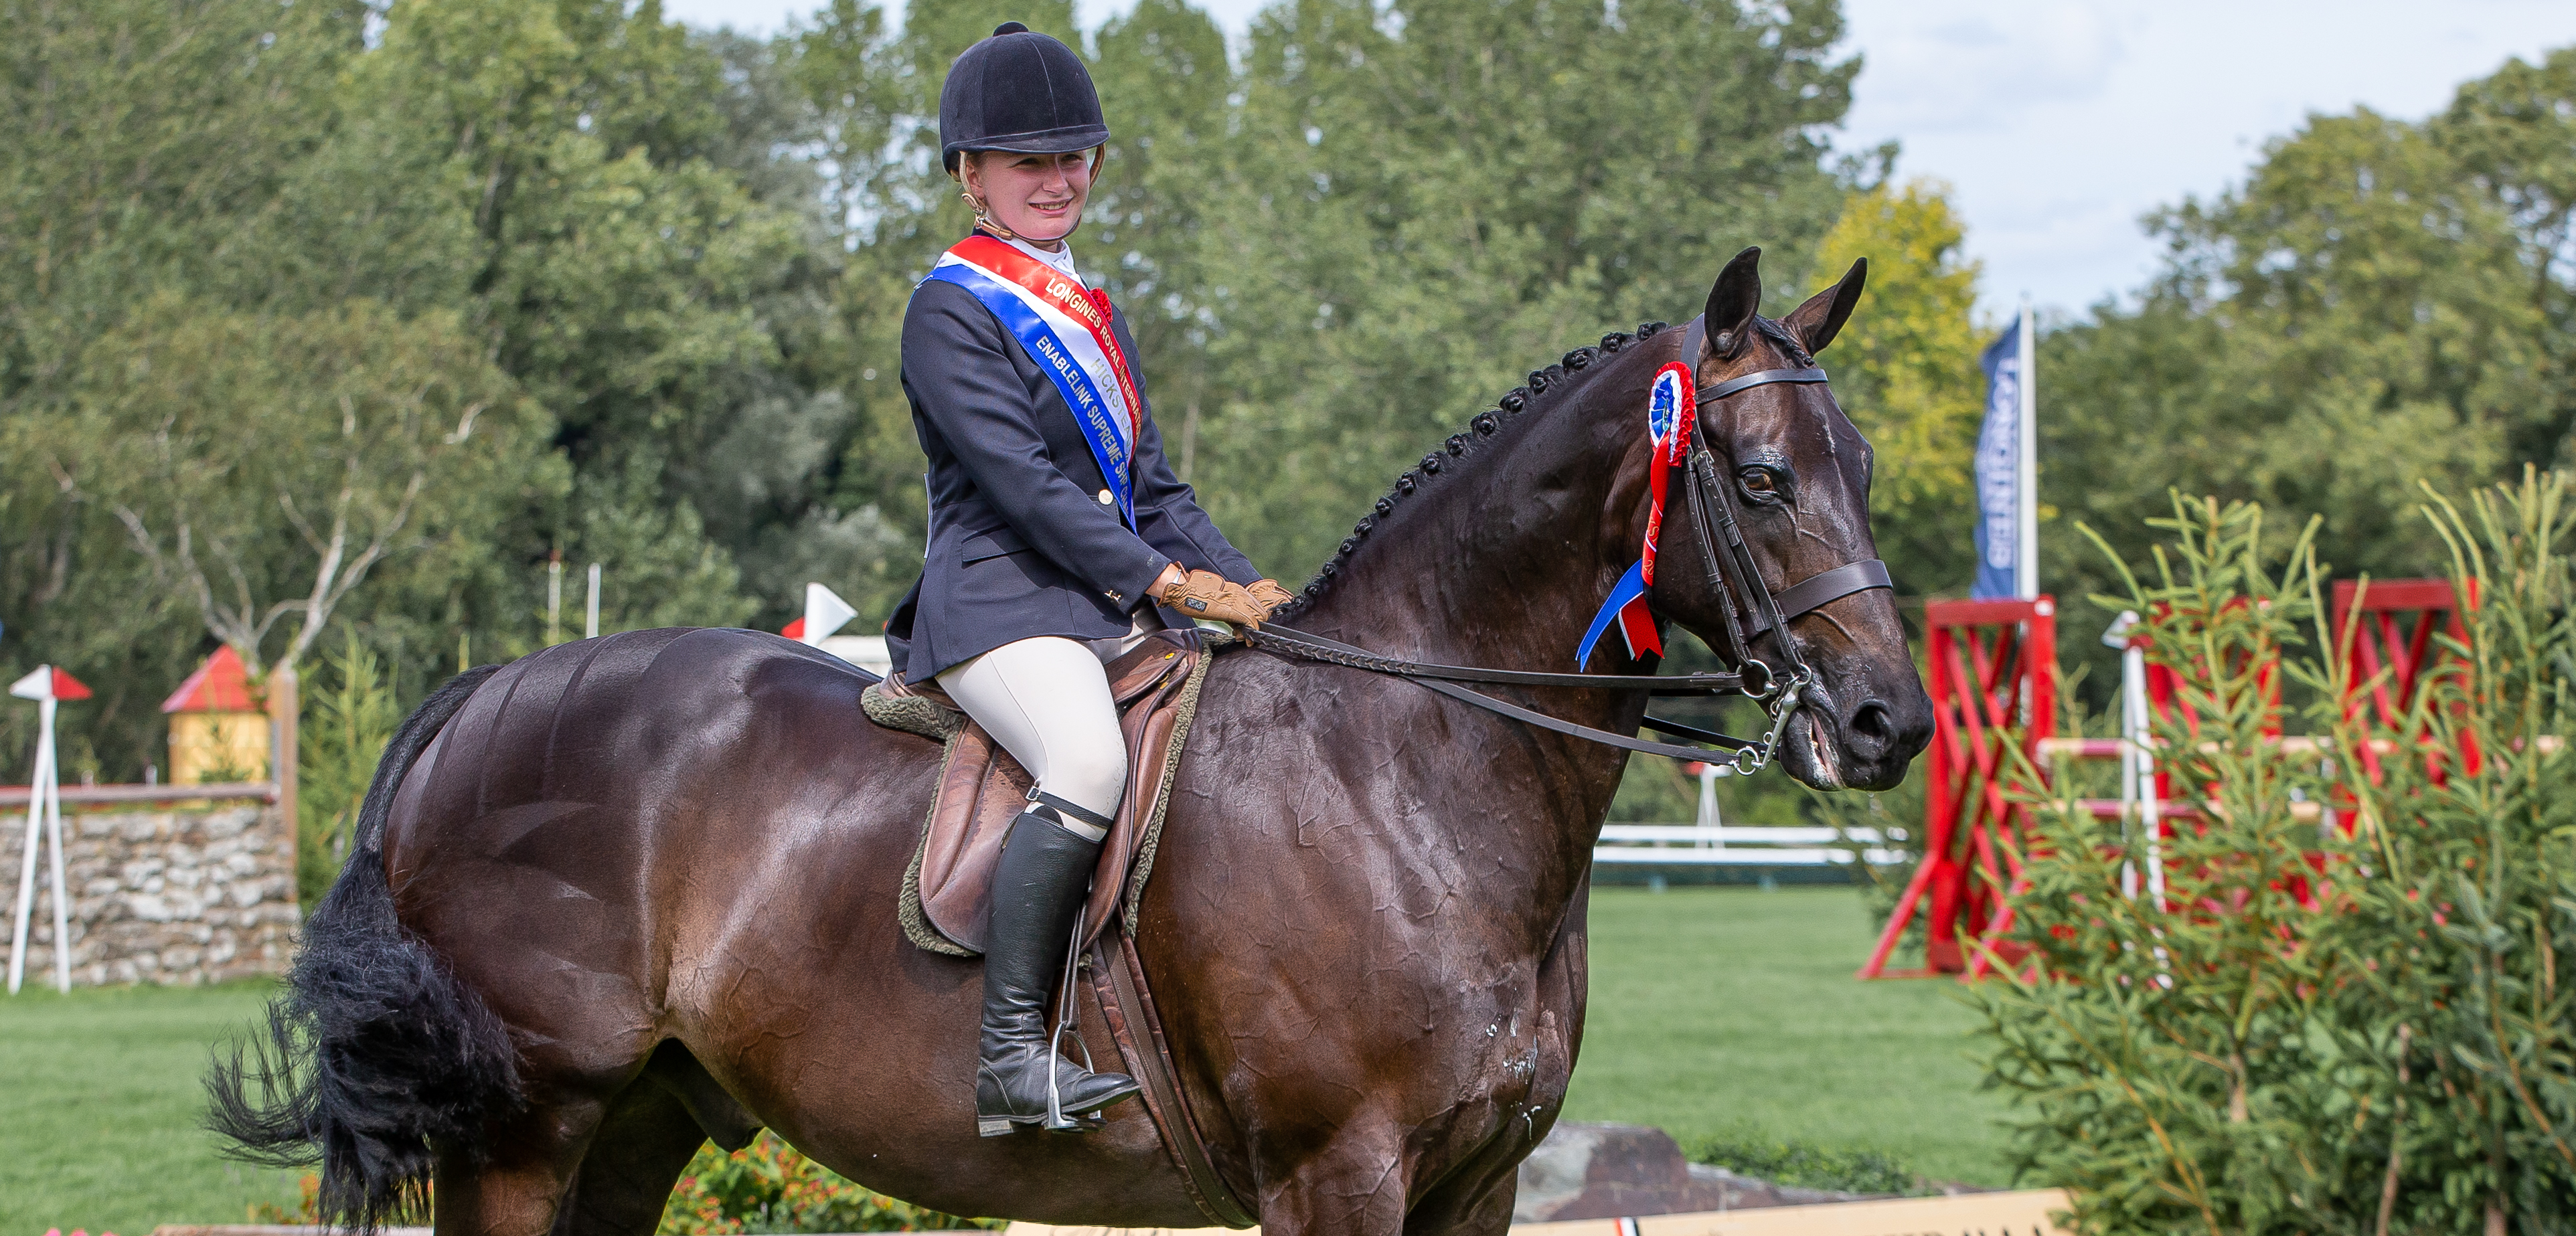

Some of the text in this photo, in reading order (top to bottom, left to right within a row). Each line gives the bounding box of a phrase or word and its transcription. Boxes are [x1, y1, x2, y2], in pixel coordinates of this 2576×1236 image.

[1045, 277, 1102, 328] LONGINES
[1099, 325, 1120, 369] ROYAL
[1036, 335, 1094, 410] ENABLELINK
[1087, 405, 1123, 465] SUPREME
[1091, 357, 1131, 448] HICKSTEAD
